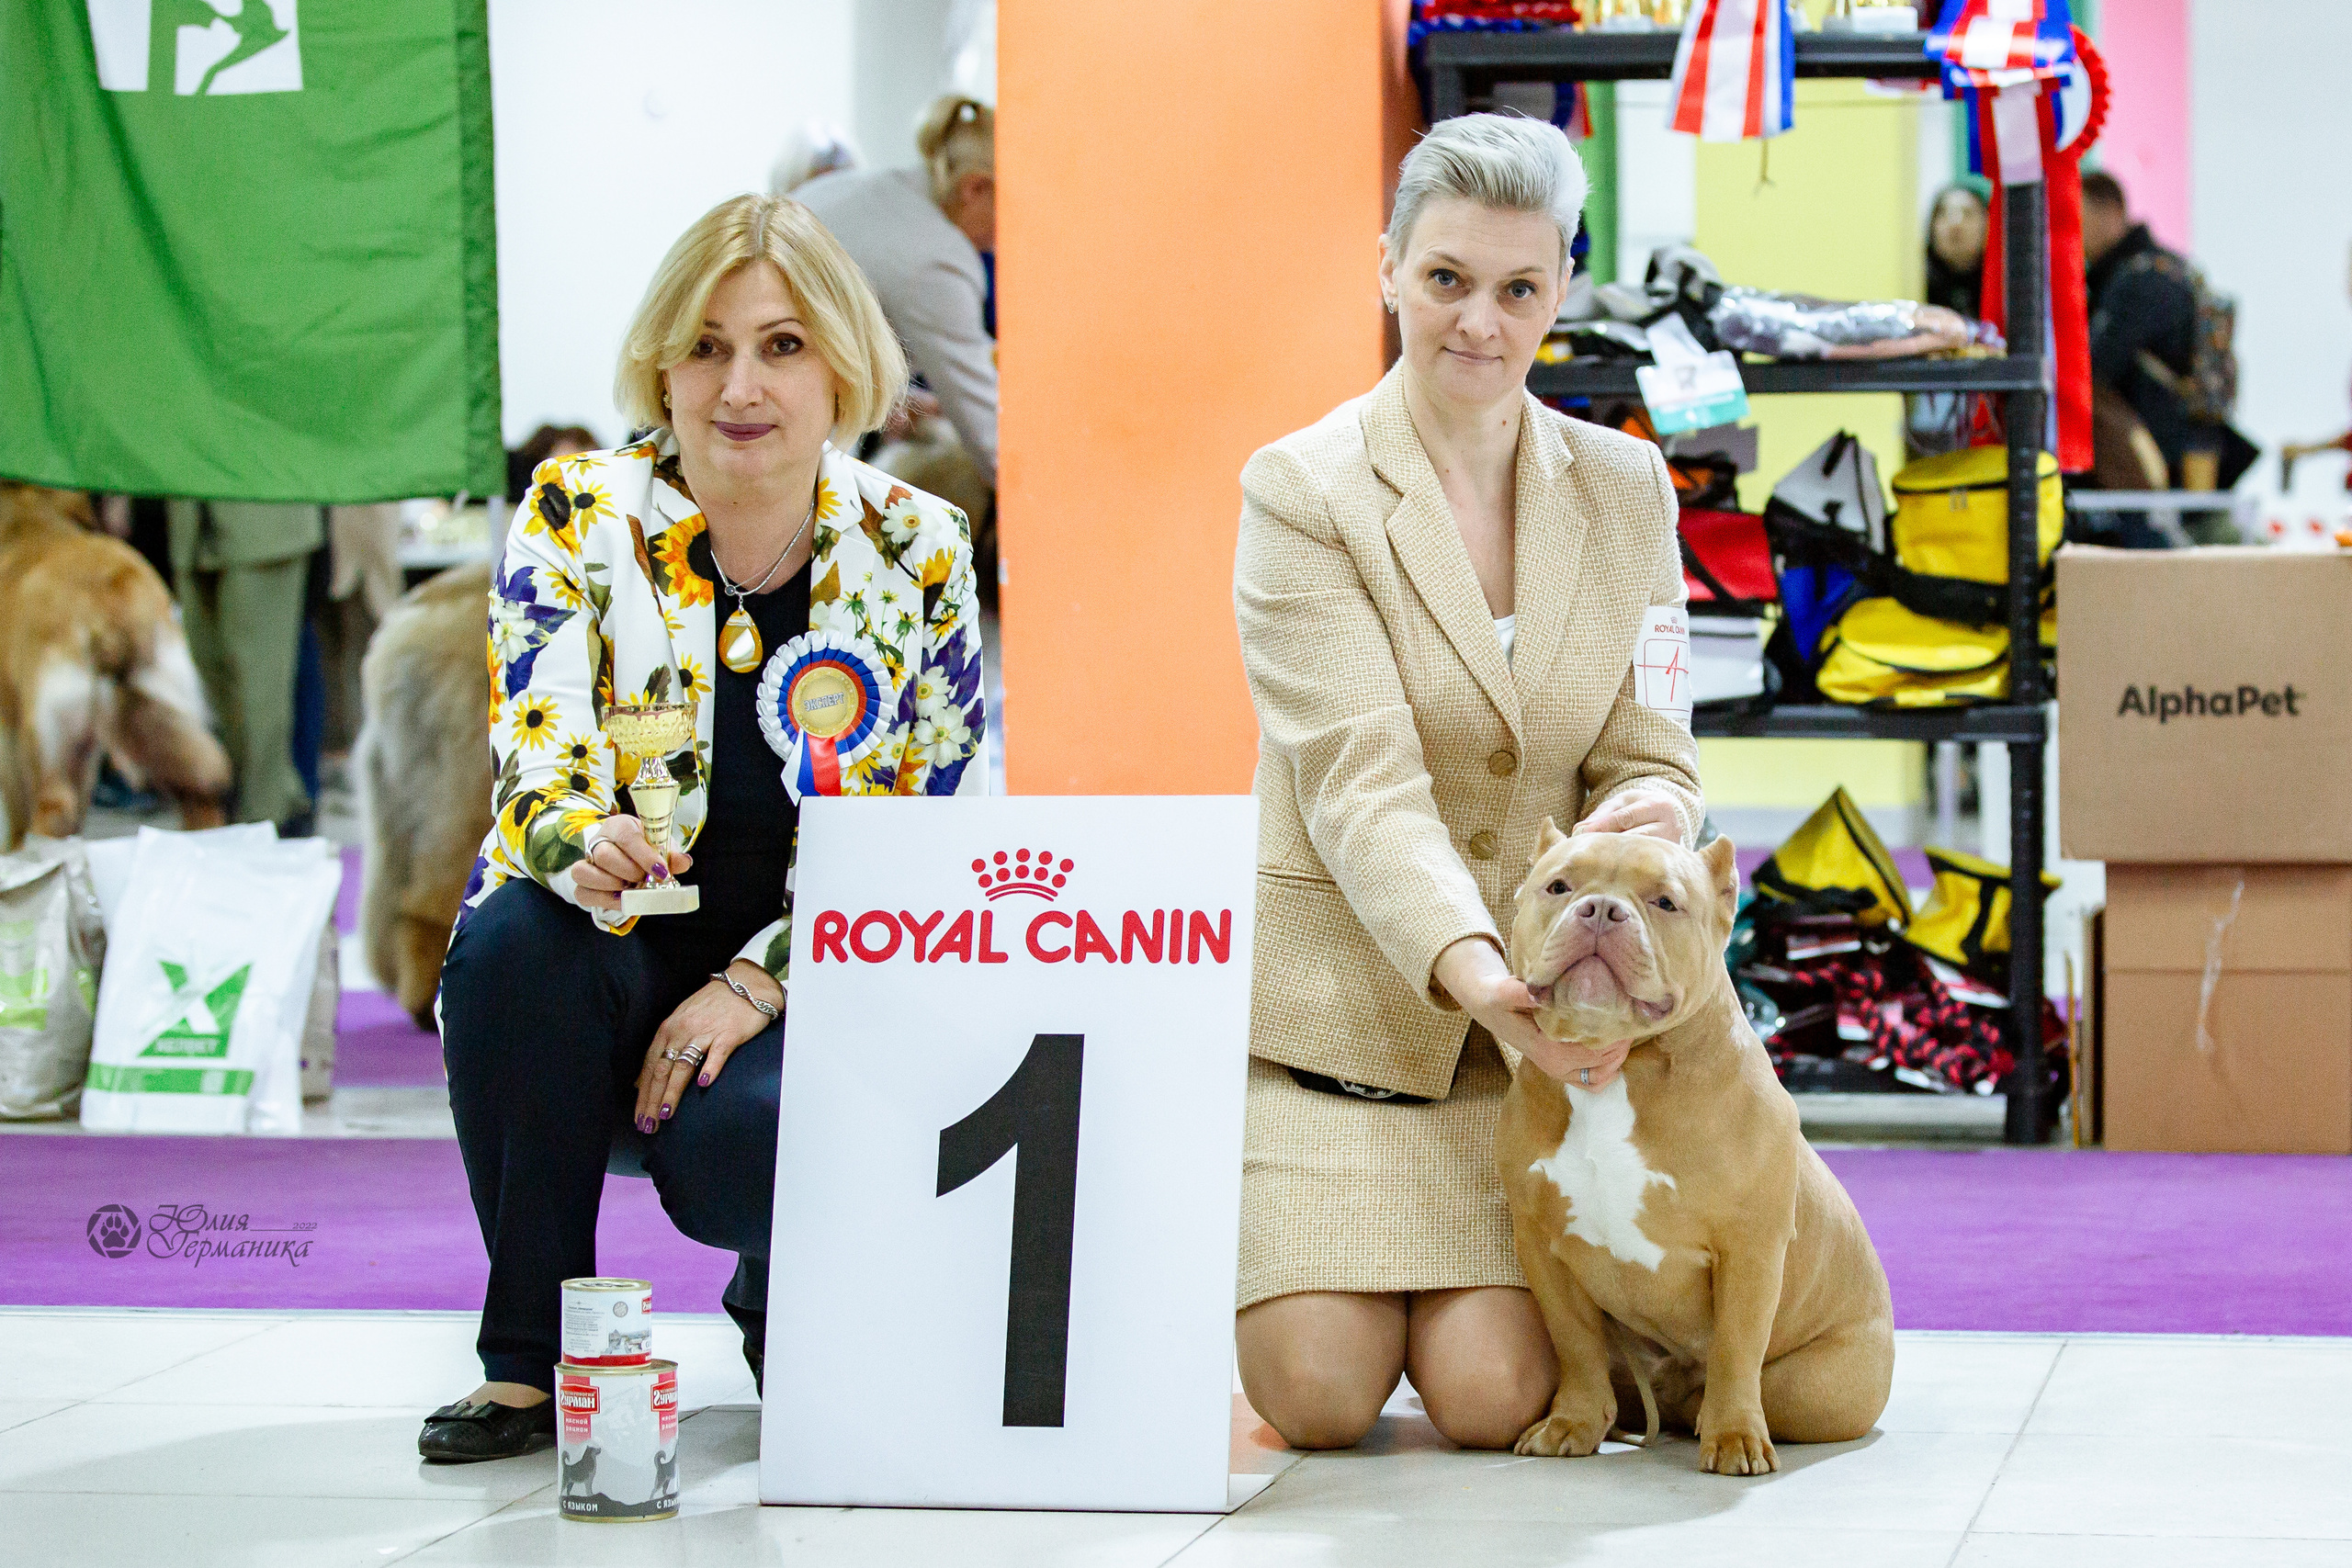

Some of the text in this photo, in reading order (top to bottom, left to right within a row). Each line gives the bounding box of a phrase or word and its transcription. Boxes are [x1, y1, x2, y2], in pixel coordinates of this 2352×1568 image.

[1655, 624, 1675, 633] ROYAL
[804, 692, 845, 712] ЭКСПЕРТ
[2117, 684, 2301, 724] AlphaPet
[812, 908, 1232, 964] ROYAL CANIN
[936, 1033, 1085, 1427] 1
[567, 1501, 598, 1512] ЯЗЫКОМ
